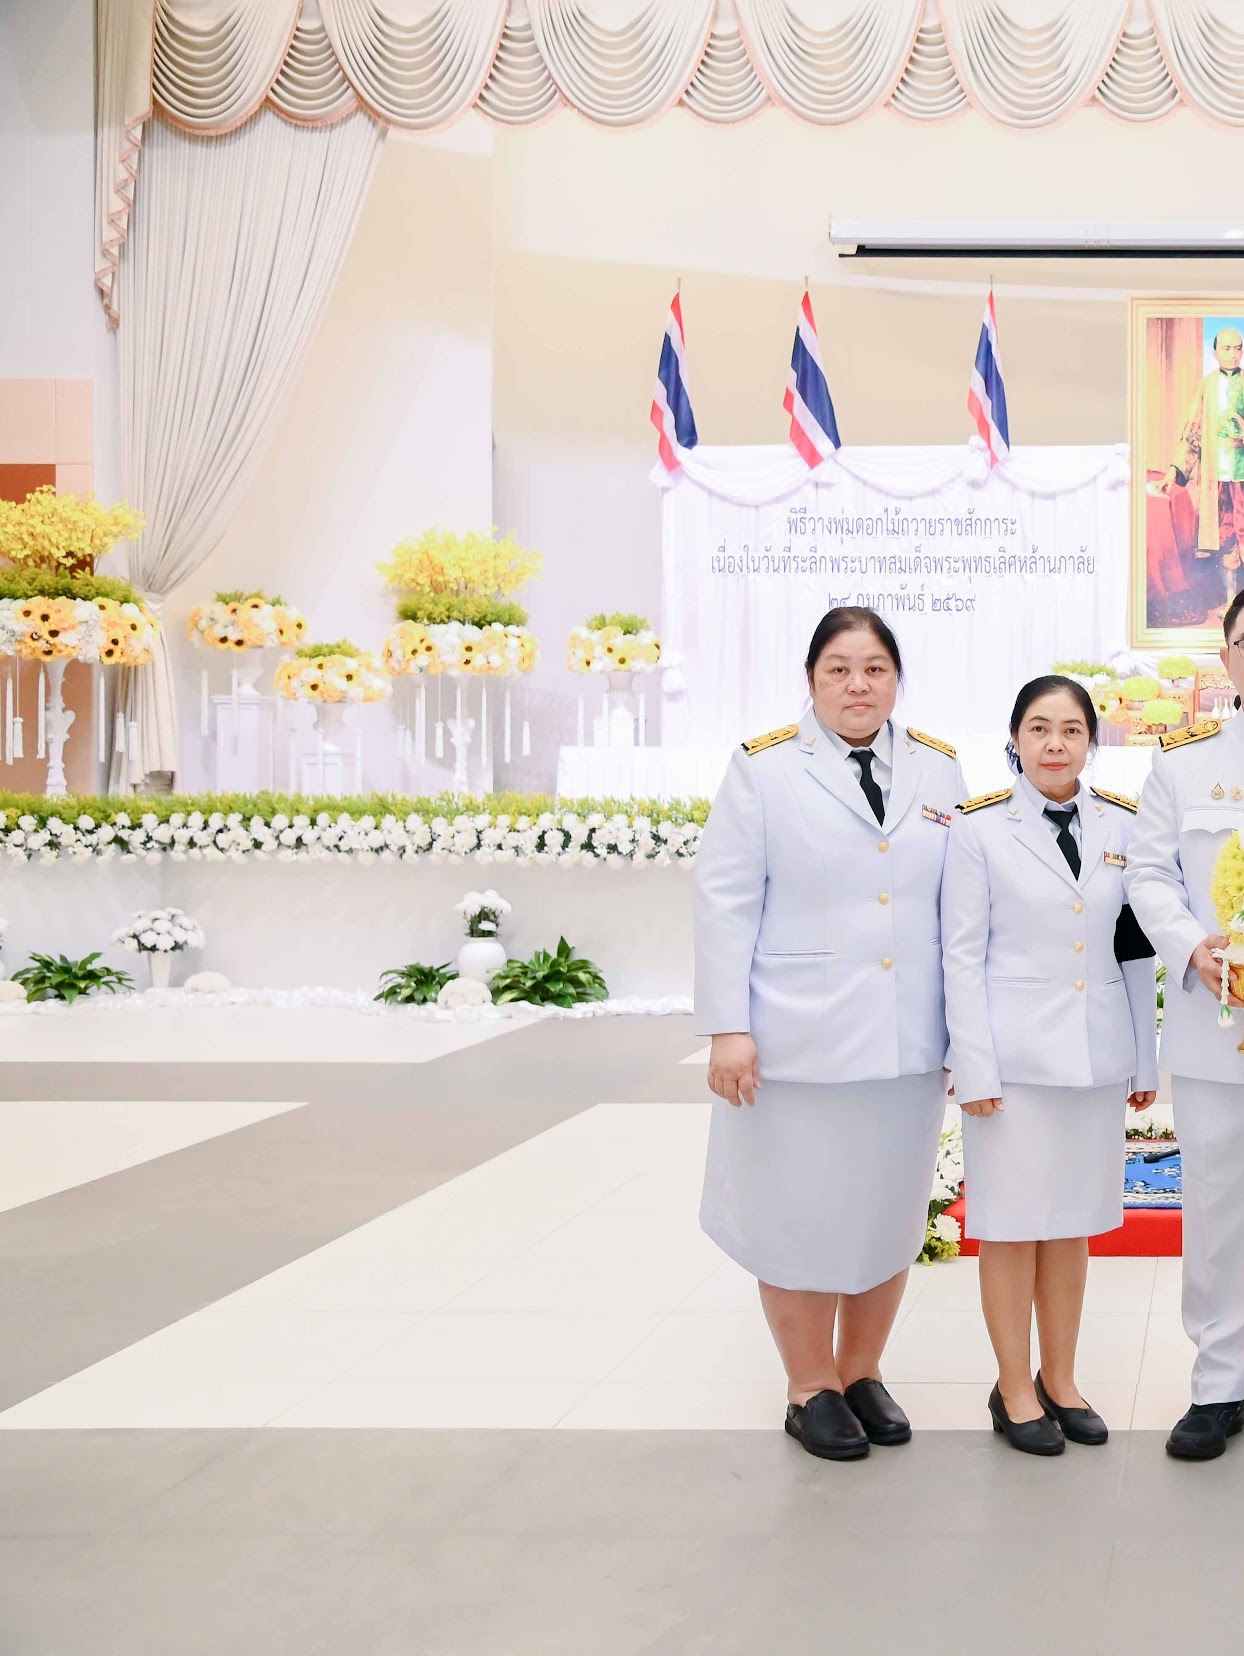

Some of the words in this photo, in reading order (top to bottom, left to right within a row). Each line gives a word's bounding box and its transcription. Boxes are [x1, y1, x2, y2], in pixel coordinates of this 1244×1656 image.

[787, 506, 1017, 545] พิธีวางพุ่มดอกไม้ถวายราชสักการะ
[856, 582, 926, 612] กมภาพันธ์
[931, 592, 976, 612] ๒๕๖๙
